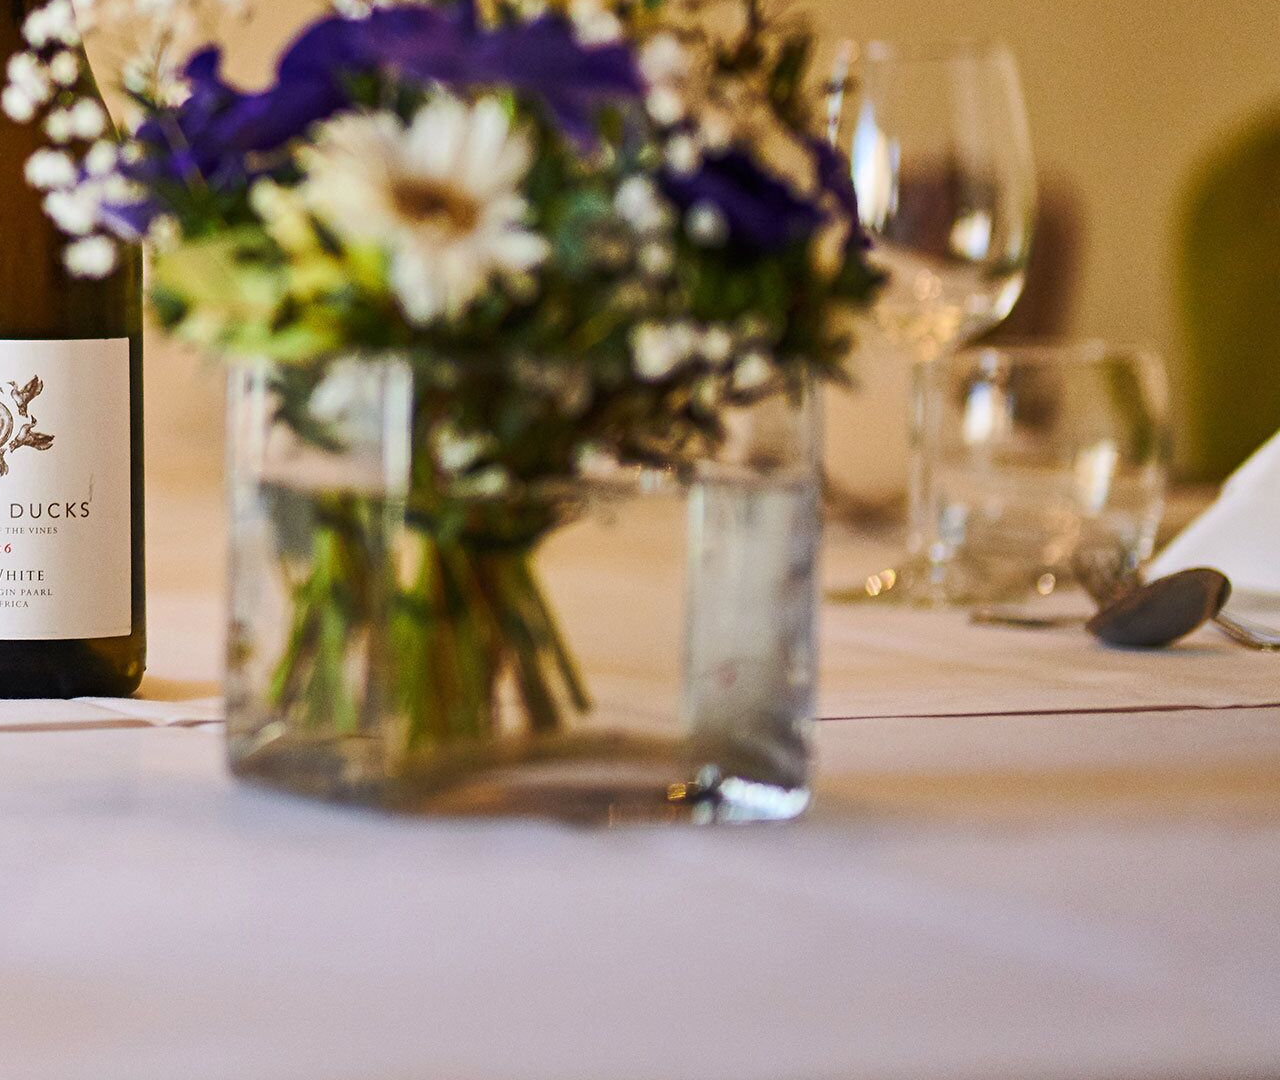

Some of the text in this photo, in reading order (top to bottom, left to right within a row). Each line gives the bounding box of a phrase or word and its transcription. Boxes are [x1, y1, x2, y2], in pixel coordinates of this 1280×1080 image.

[10, 502, 90, 519] DUCKS
[5, 526, 25, 535] THE
[29, 526, 58, 535] VINES
[20, 588, 53, 597] PAARL
